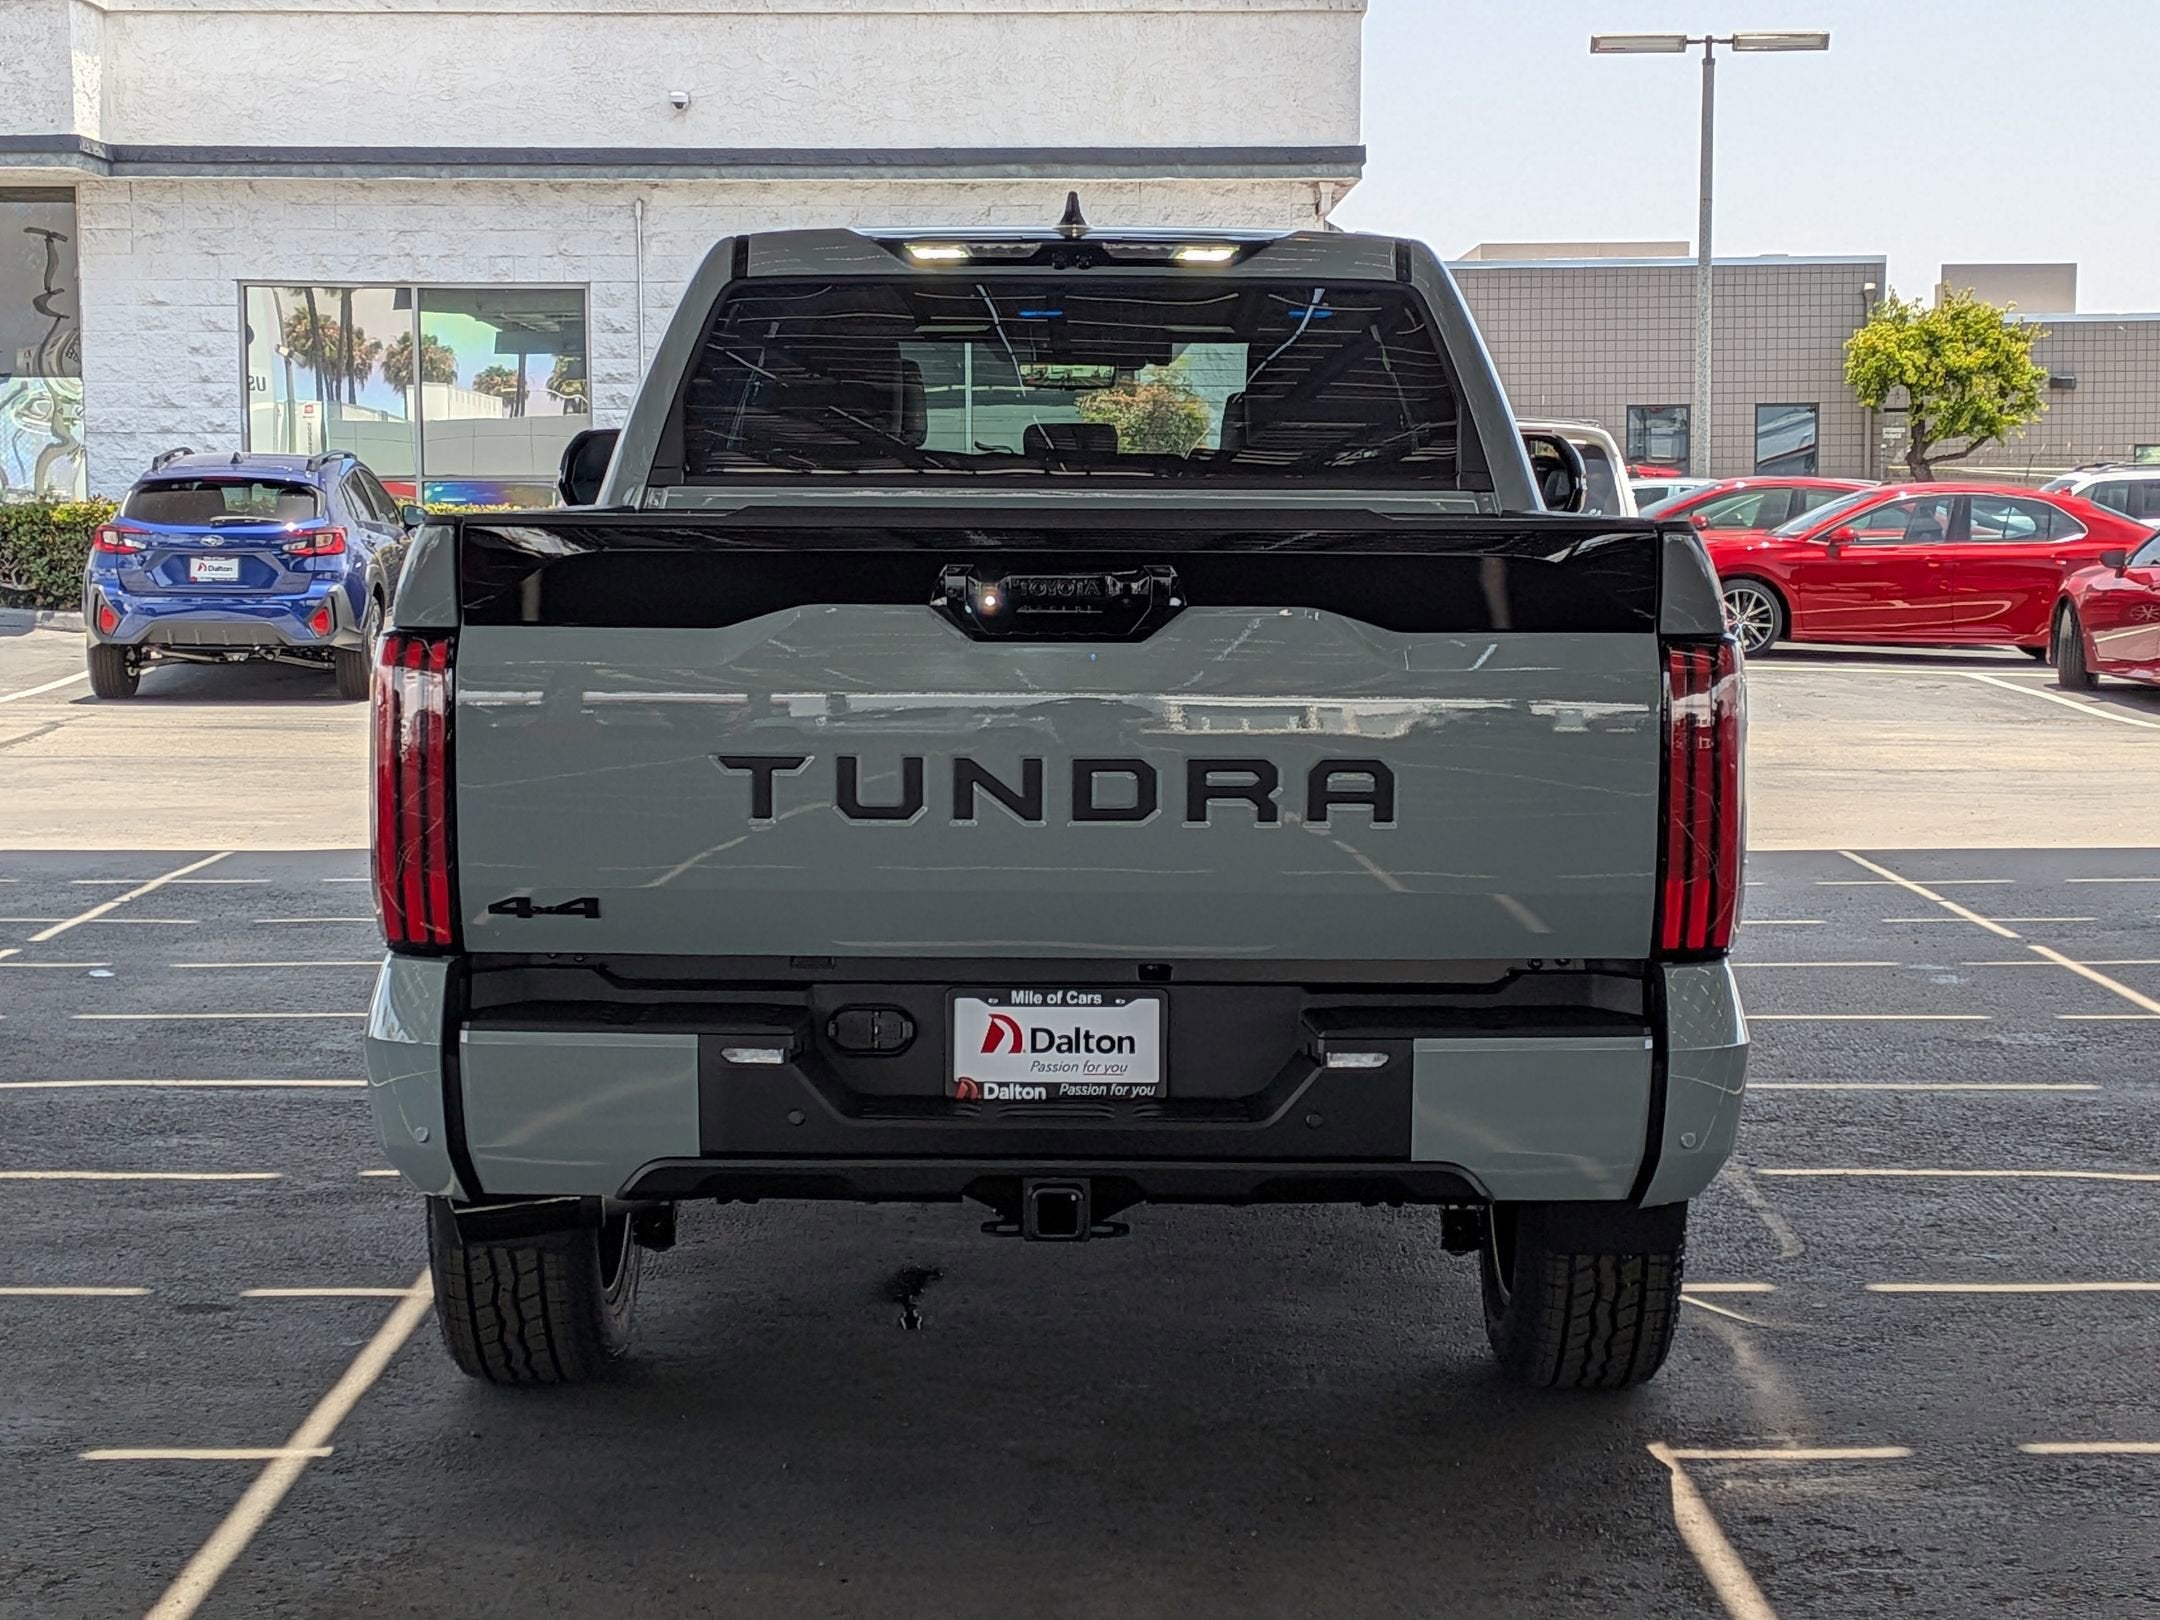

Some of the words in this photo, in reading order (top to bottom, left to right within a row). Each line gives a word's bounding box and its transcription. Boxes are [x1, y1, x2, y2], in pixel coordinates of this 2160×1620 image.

[709, 755, 1398, 828] TUNDRA
[1011, 990, 1042, 1005] Mile
[1046, 990, 1064, 1005] of
[1066, 990, 1103, 1005] Cars
[1030, 1027, 1136, 1054] Dalton
[1030, 1060, 1079, 1073] Passion
[1082, 1060, 1102, 1074] for
[1104, 1063, 1128, 1075] you
[983, 1083, 1047, 1100] Dalton
[1059, 1083, 1107, 1096] Passion
[1109, 1083, 1128, 1096] for
[1129, 1084, 1156, 1098] you
